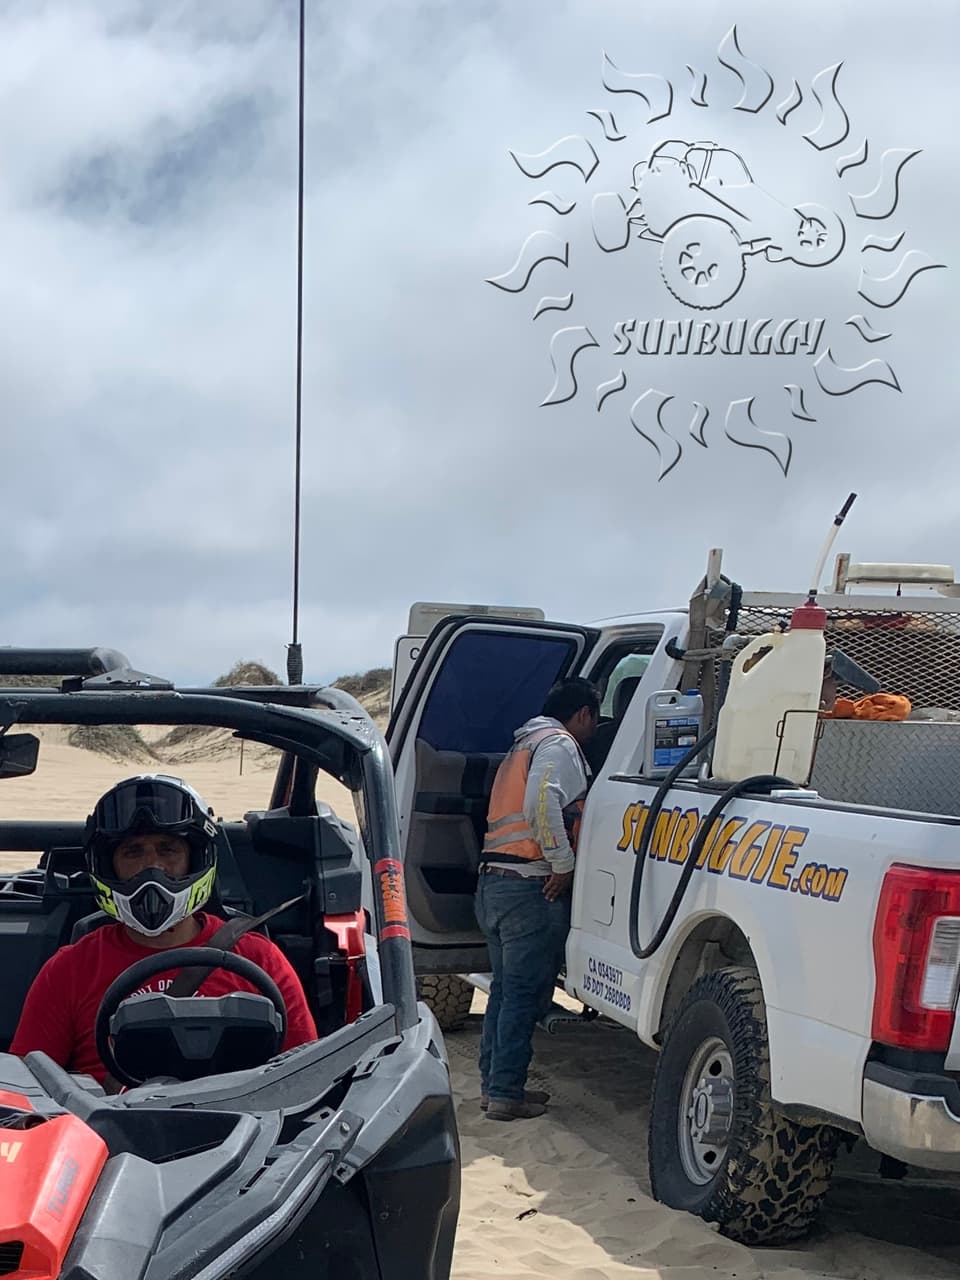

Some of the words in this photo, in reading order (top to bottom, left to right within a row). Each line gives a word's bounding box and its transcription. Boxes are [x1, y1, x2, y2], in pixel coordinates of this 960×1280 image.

[588, 956, 597, 975] CA
[583, 974, 591, 991] US
[591, 977, 604, 998] DOT
